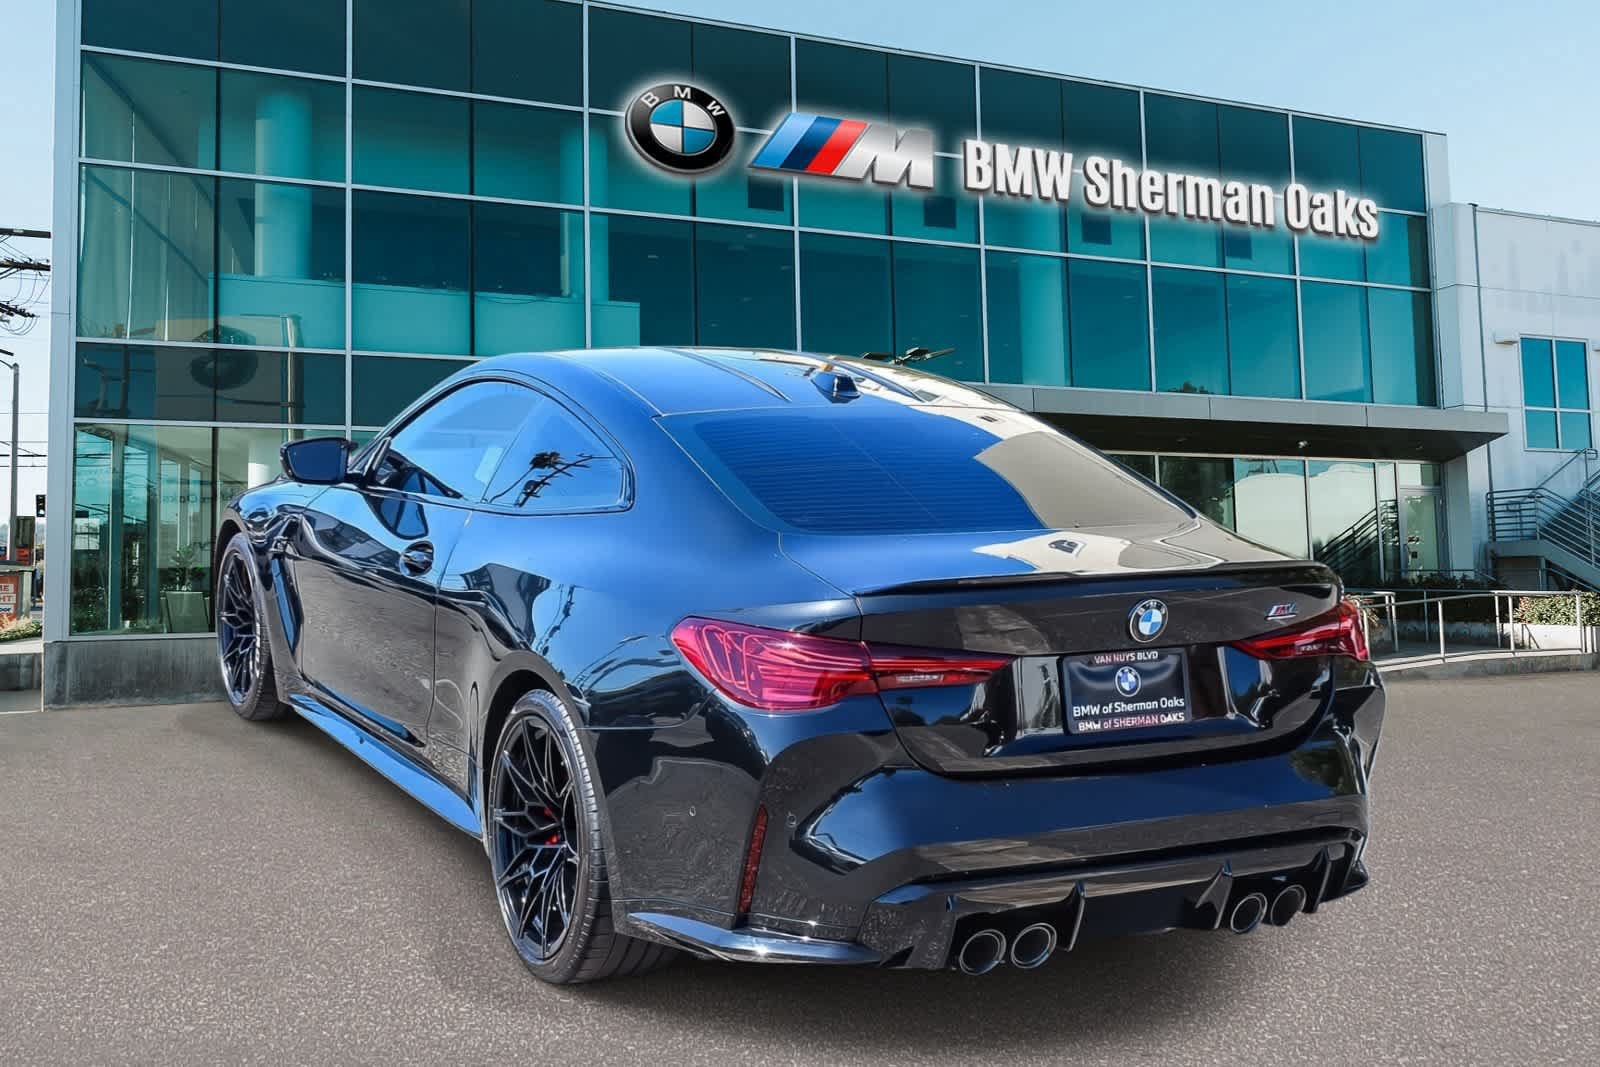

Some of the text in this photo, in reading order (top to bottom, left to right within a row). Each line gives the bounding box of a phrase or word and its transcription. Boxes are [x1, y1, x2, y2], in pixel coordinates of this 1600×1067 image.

[641, 84, 725, 118] BMW
[964, 138, 1381, 240] BMW Sherman Oaks
[1094, 650, 1158, 664] VAN NUYS BLVD
[1073, 696, 1185, 717] BMW of Sherman Oaks
[1078, 712, 1185, 732] BMW of SHERMAN OAKS
